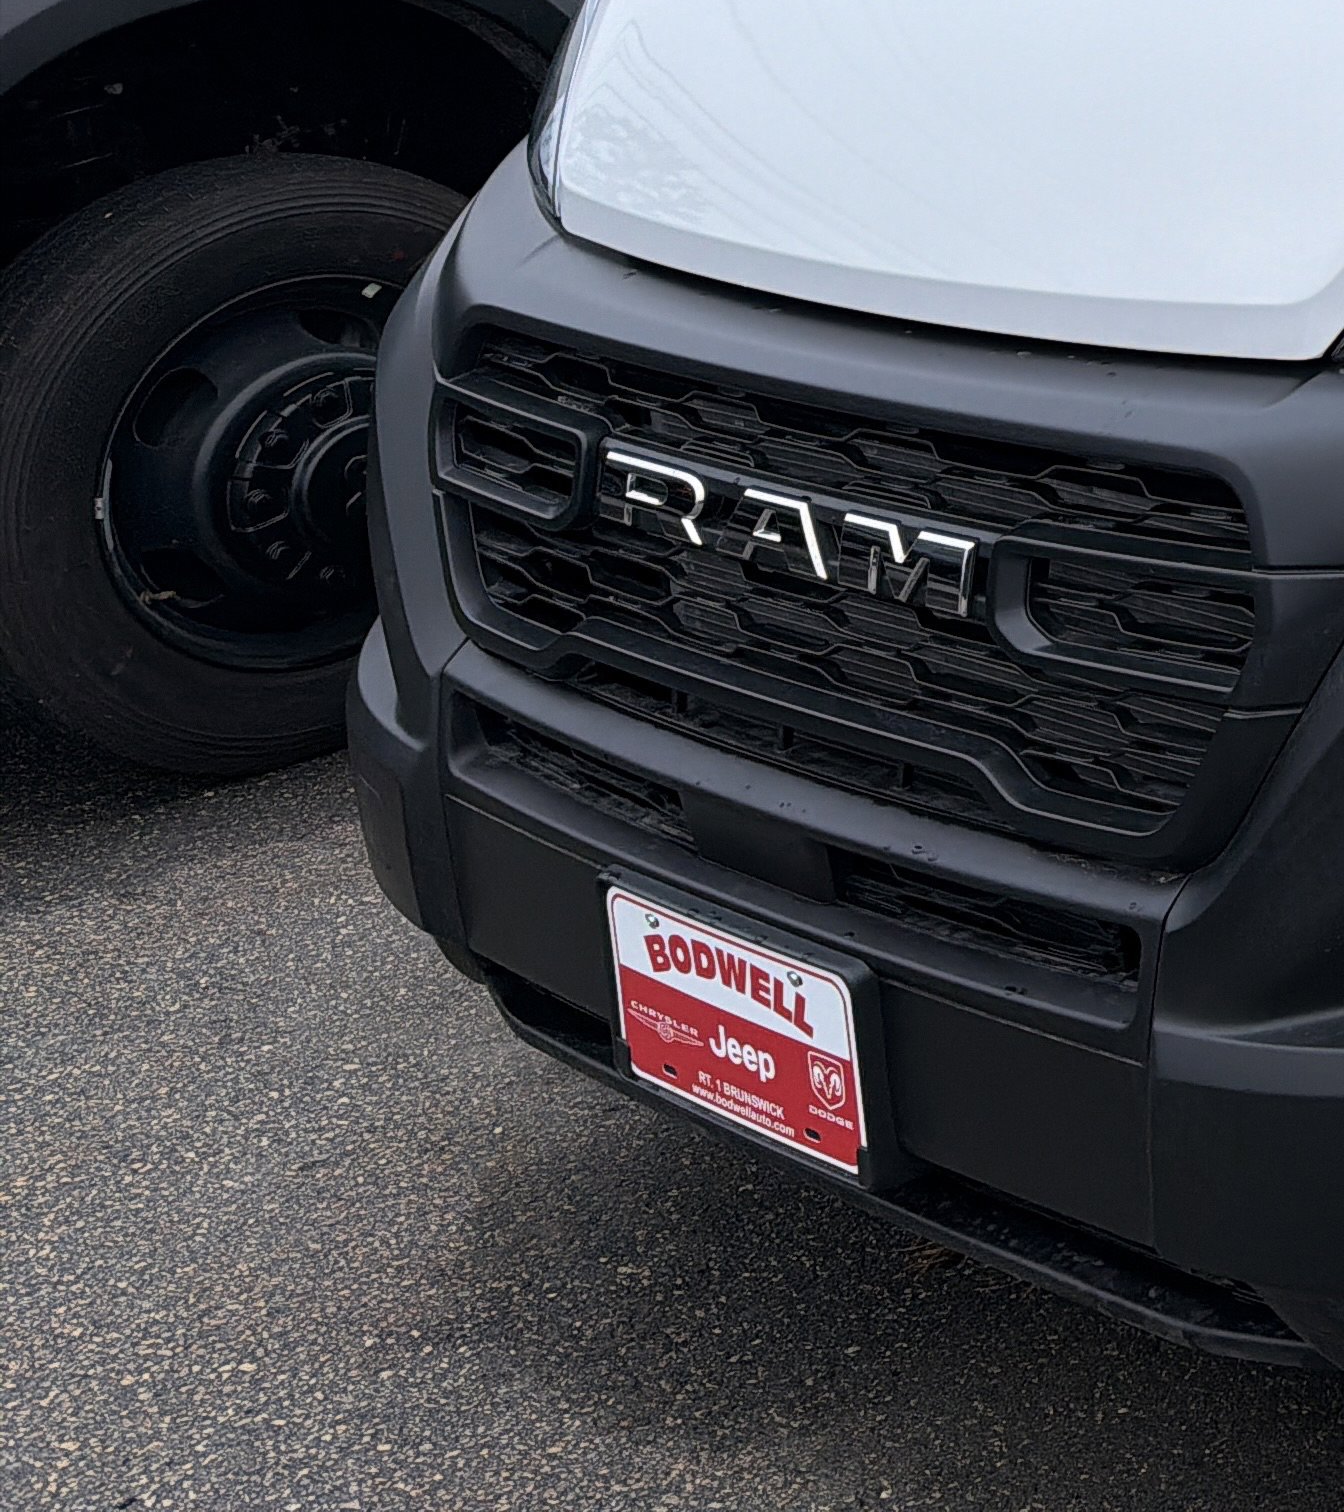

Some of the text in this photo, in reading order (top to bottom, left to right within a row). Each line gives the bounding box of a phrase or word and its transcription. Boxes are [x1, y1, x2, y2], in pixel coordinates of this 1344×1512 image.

[600, 450, 976, 618] RAM
[643, 934, 814, 1040] BODWELL
[630, 999, 699, 1037] CHRYSLER
[709, 1024, 776, 1082] Jeep
[692, 1082, 795, 1138] www.bodwellauto.com
[698, 1070, 785, 1120] RT. 1 BRUNSWICK
[808, 1104, 855, 1131] DODGE
